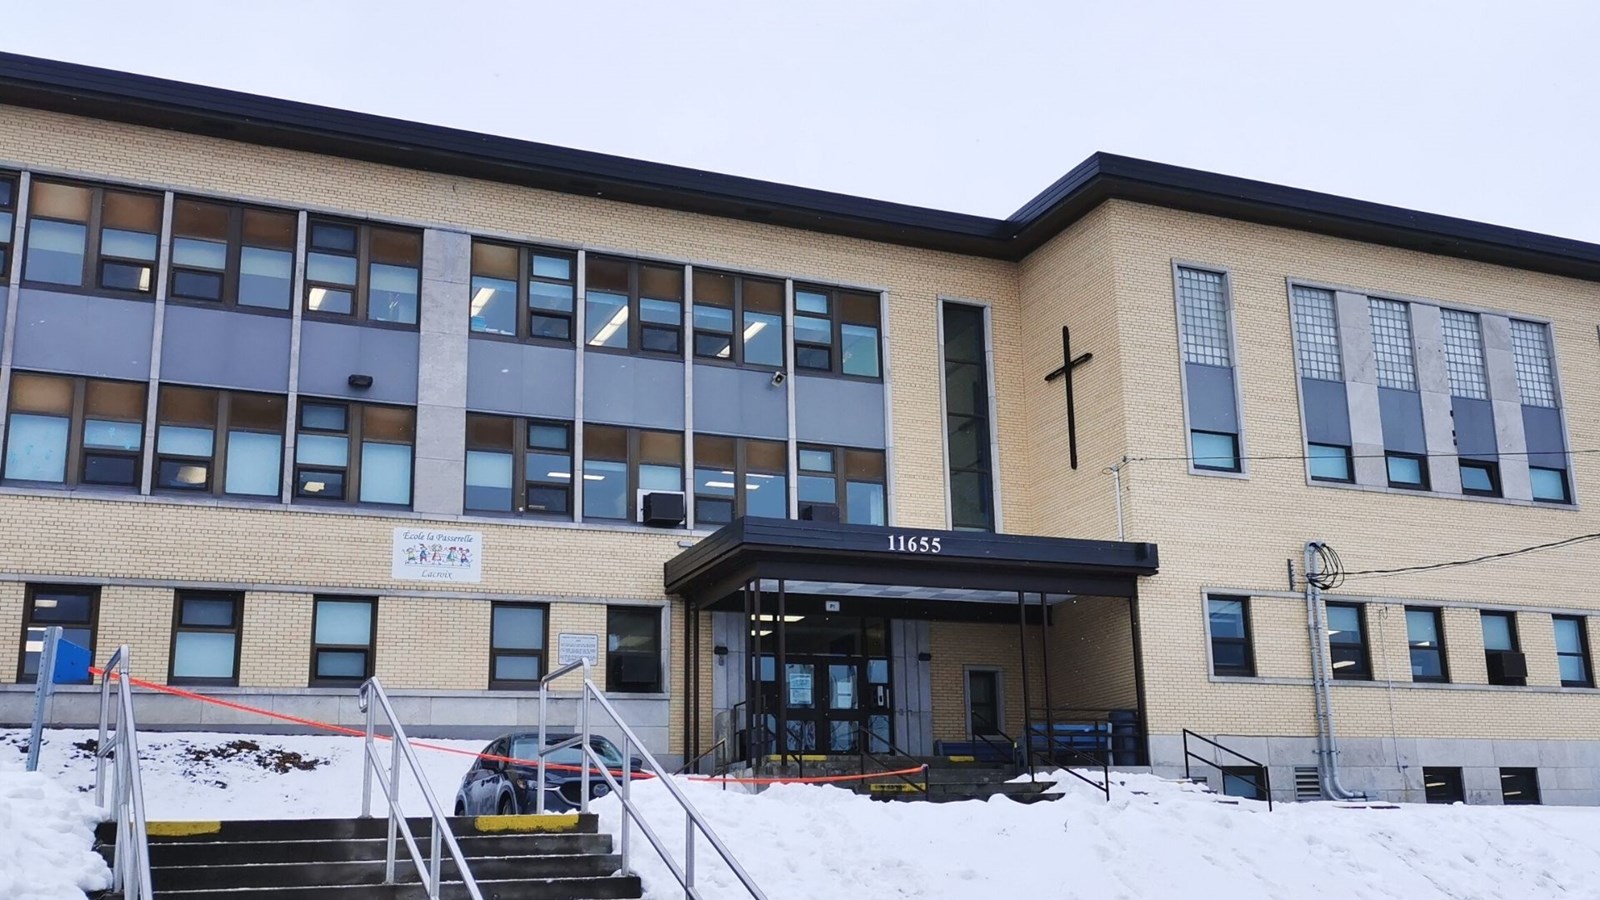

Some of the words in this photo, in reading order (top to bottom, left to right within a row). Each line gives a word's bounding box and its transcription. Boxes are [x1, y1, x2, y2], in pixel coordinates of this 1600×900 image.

[402, 530, 425, 540] École
[427, 532, 434, 541] la
[436, 533, 473, 543] Passerelle
[888, 535, 941, 553] 11655
[421, 569, 453, 579] Lacroix
